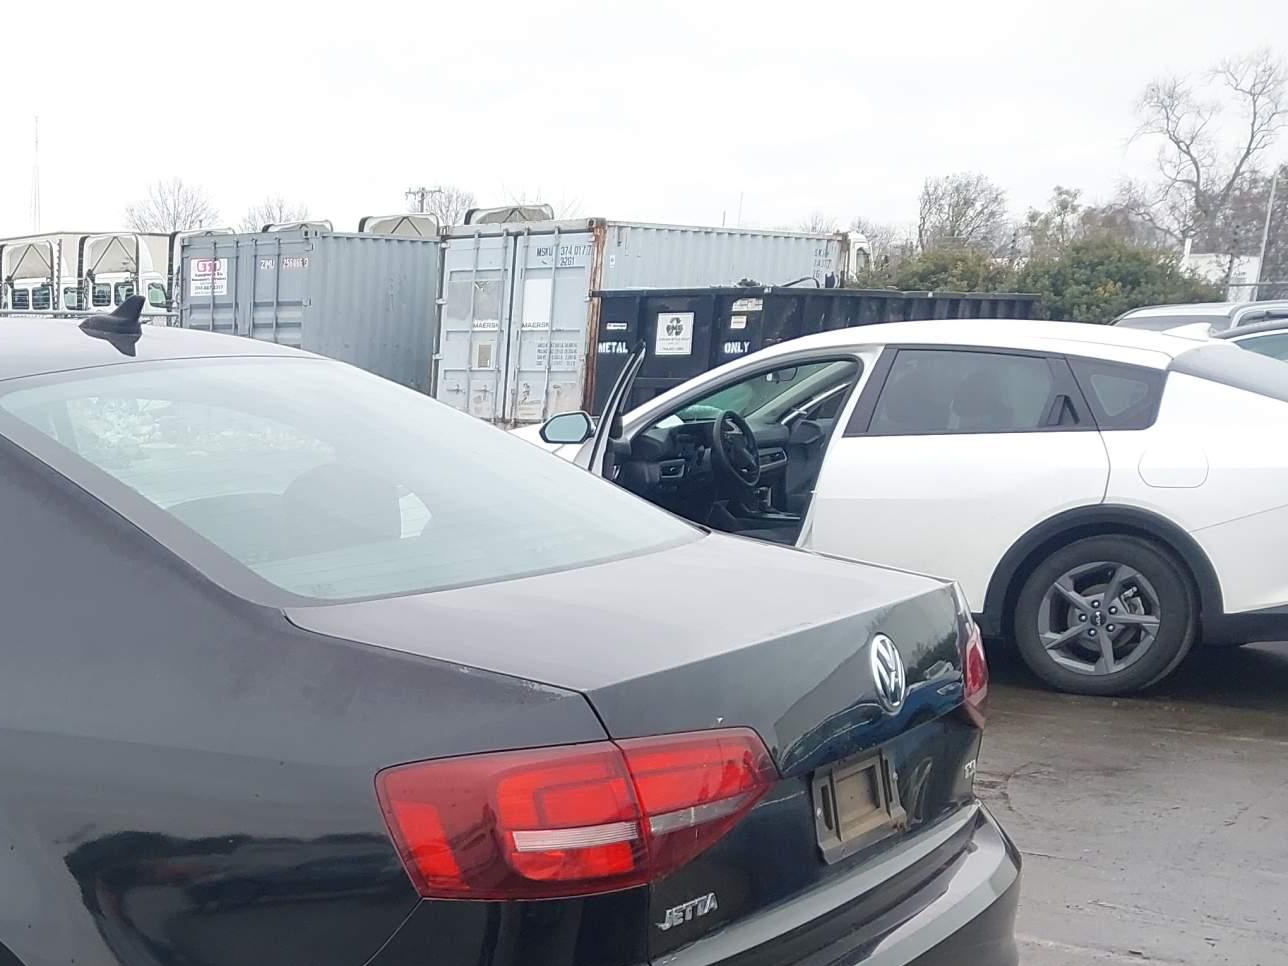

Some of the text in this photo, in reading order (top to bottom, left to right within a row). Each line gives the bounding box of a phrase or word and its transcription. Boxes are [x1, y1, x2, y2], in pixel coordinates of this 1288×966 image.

[598, 341, 751, 354] METAL ONLY
[654, 892, 719, 931] JETTA
